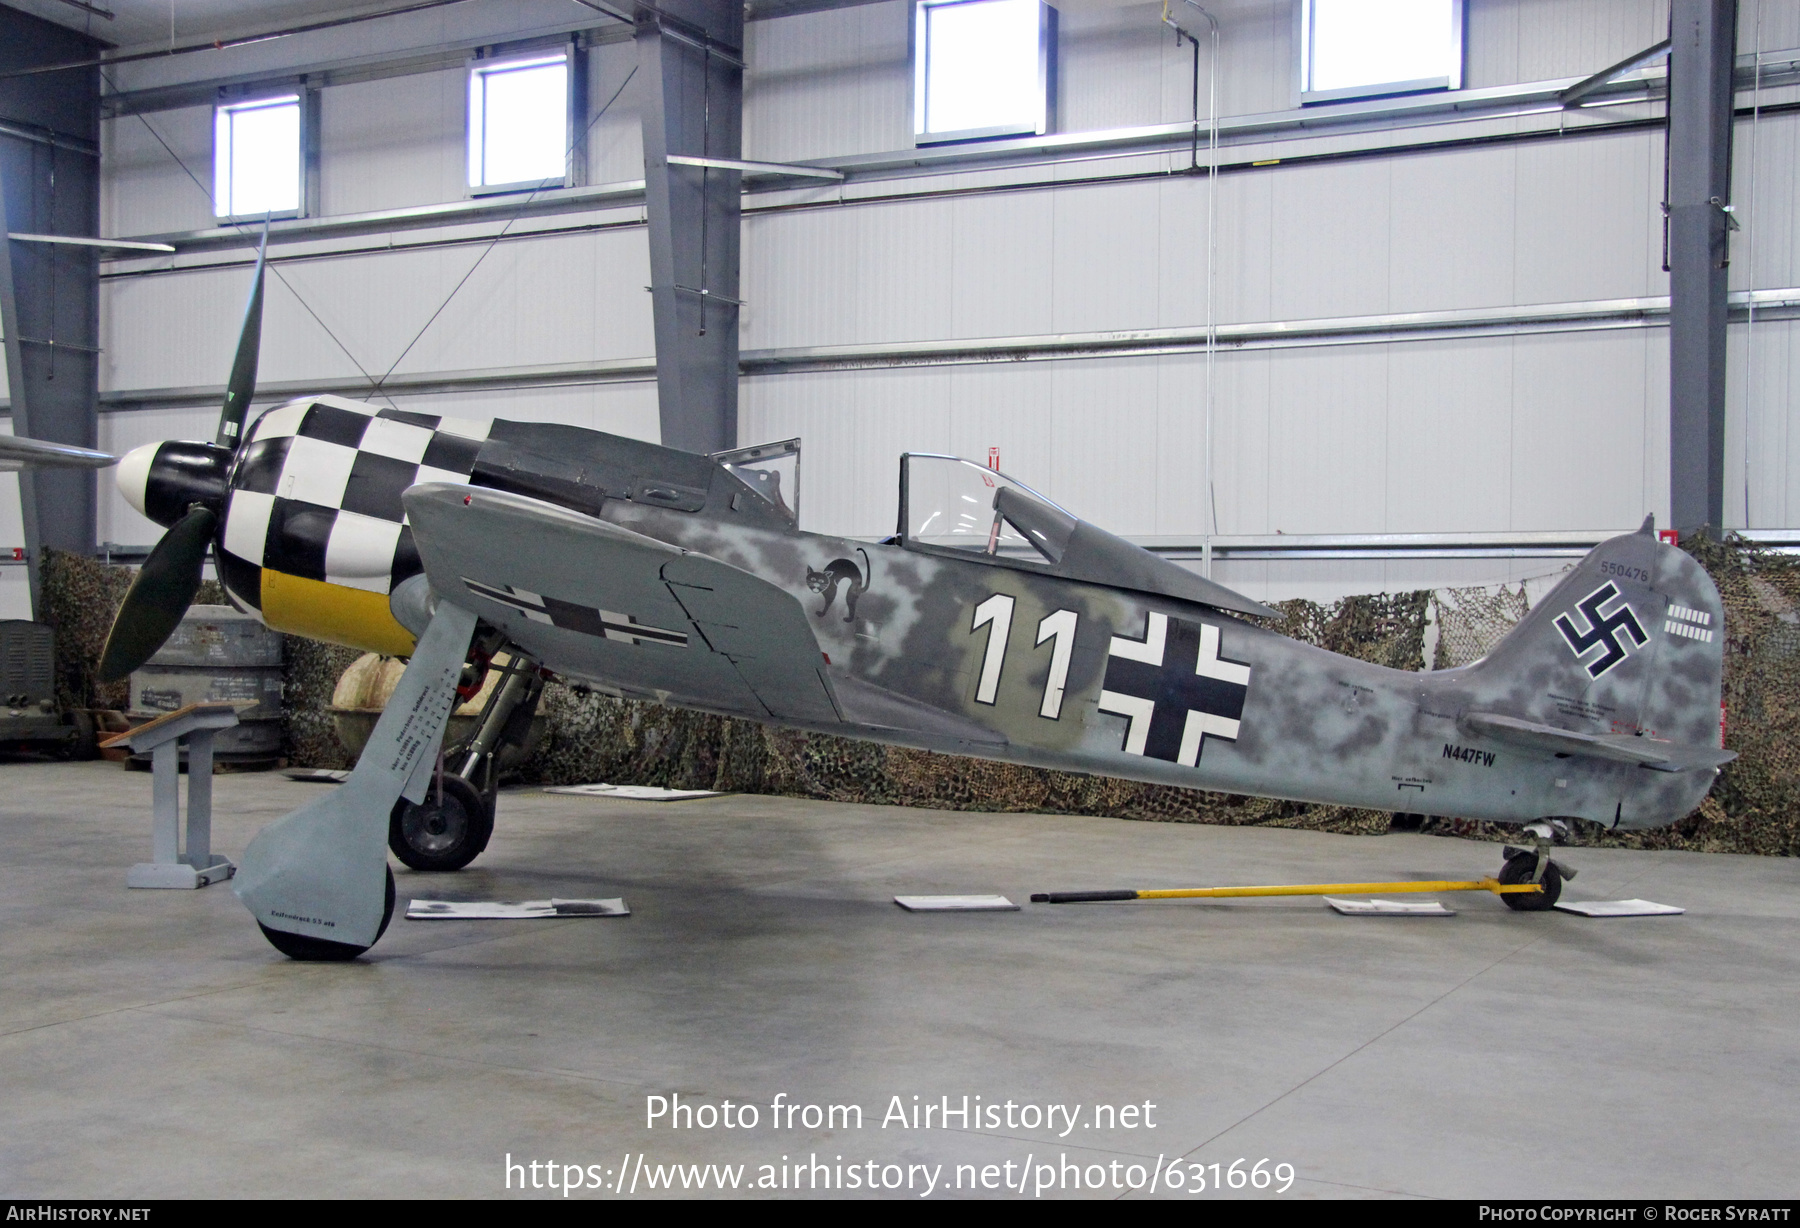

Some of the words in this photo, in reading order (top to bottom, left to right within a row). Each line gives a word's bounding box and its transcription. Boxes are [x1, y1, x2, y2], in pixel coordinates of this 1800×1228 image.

[1600, 561, 1649, 582] 550476
[969, 592, 1078, 722] 11
[1442, 743, 1496, 768] N447FW
